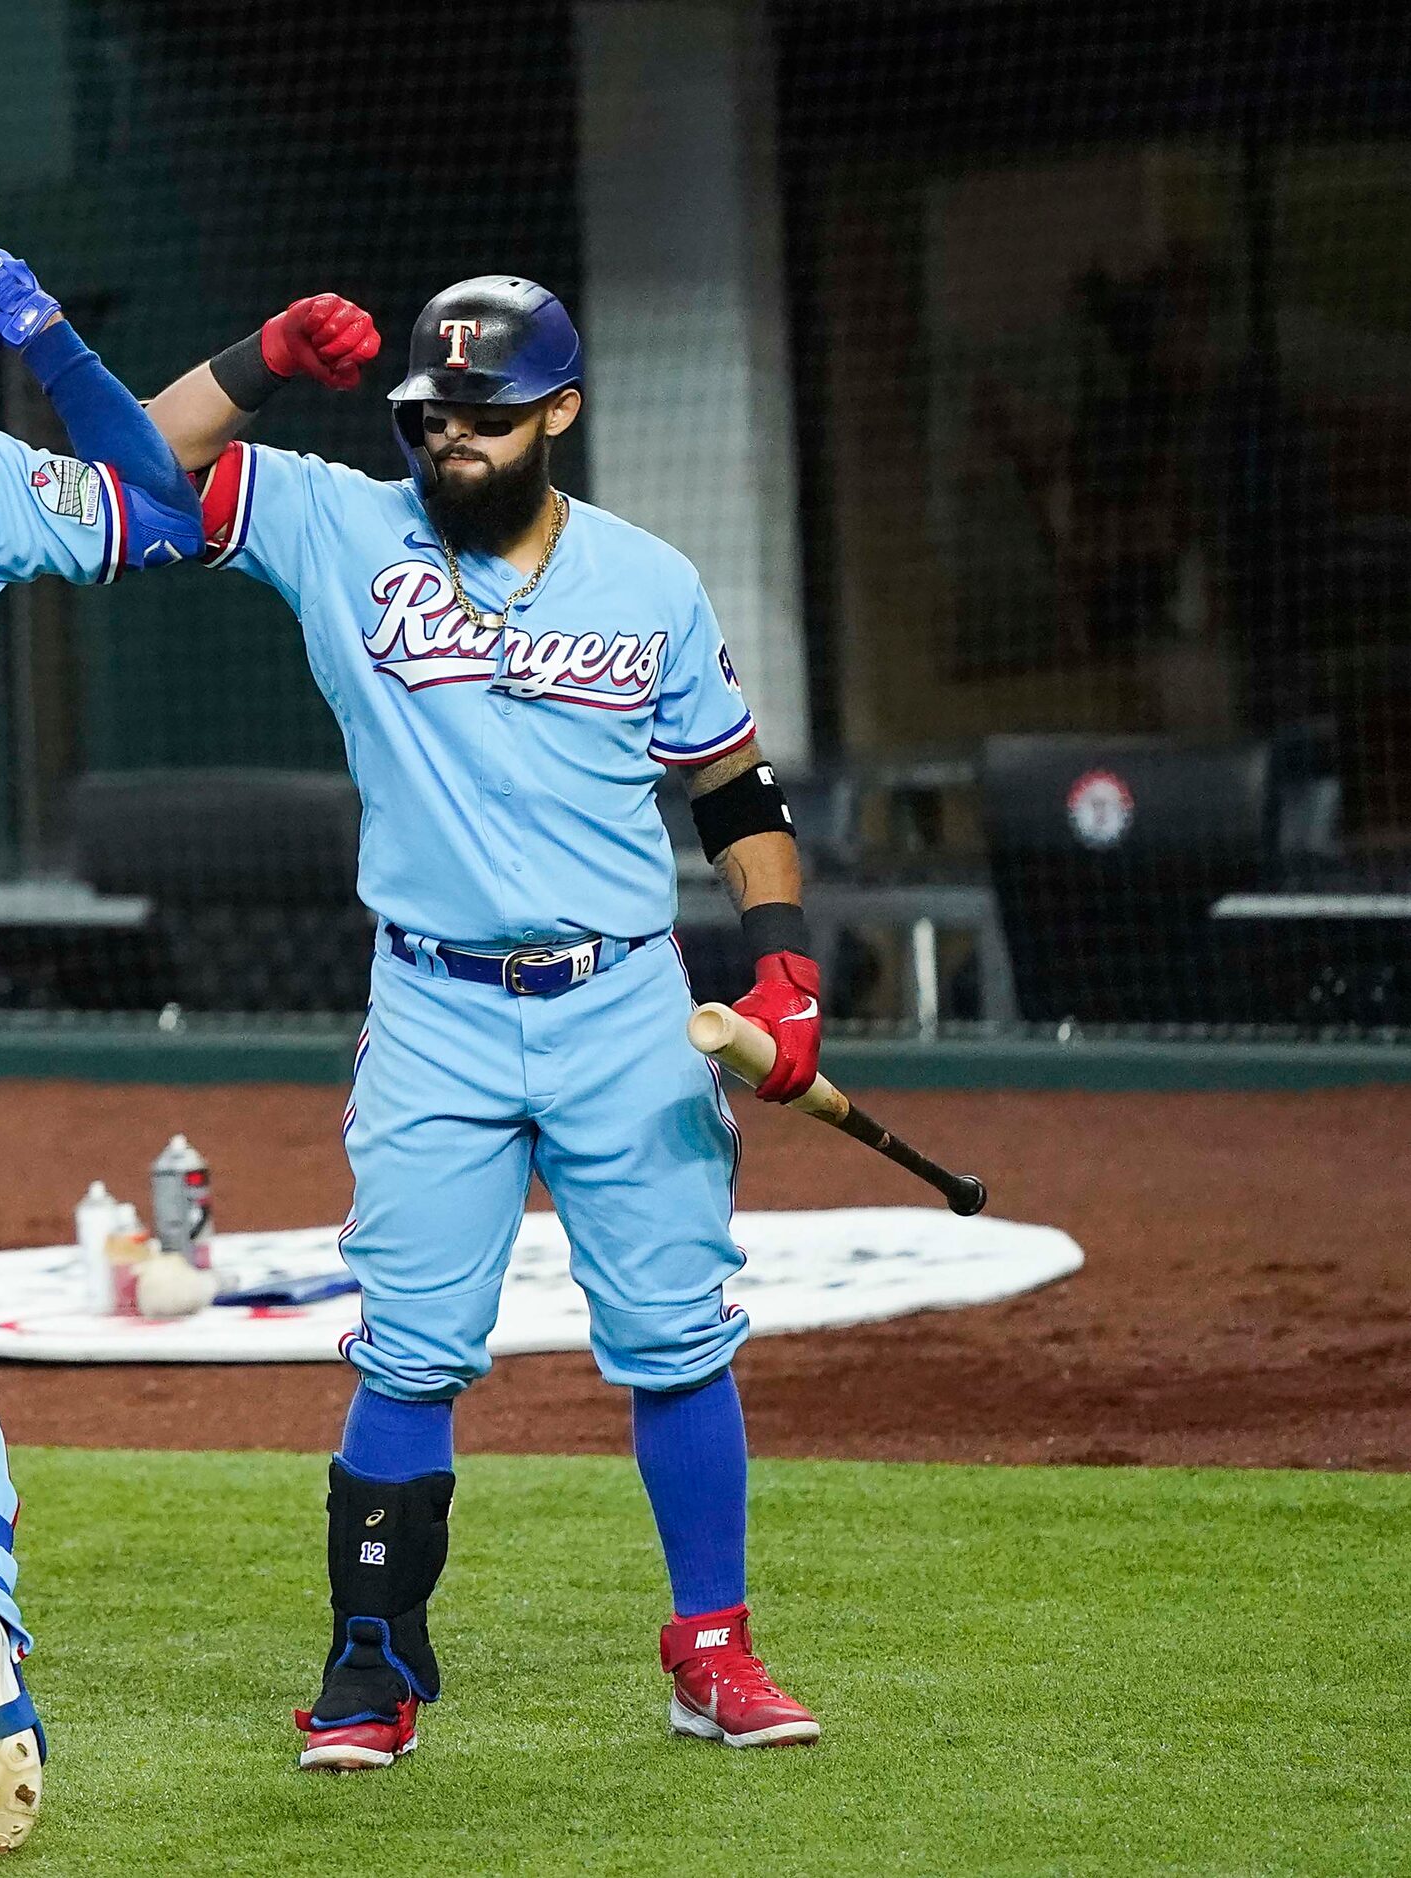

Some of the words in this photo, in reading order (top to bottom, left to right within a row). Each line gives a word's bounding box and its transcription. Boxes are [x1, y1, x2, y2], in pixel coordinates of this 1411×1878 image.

[437, 319, 481, 370] T
[85, 482, 98, 521] INAUGURAL
[361, 559, 669, 711] Rangers
[576, 955, 591, 977] 12
[359, 1541, 387, 1566] 12
[694, 1627, 731, 1650] NIKE
